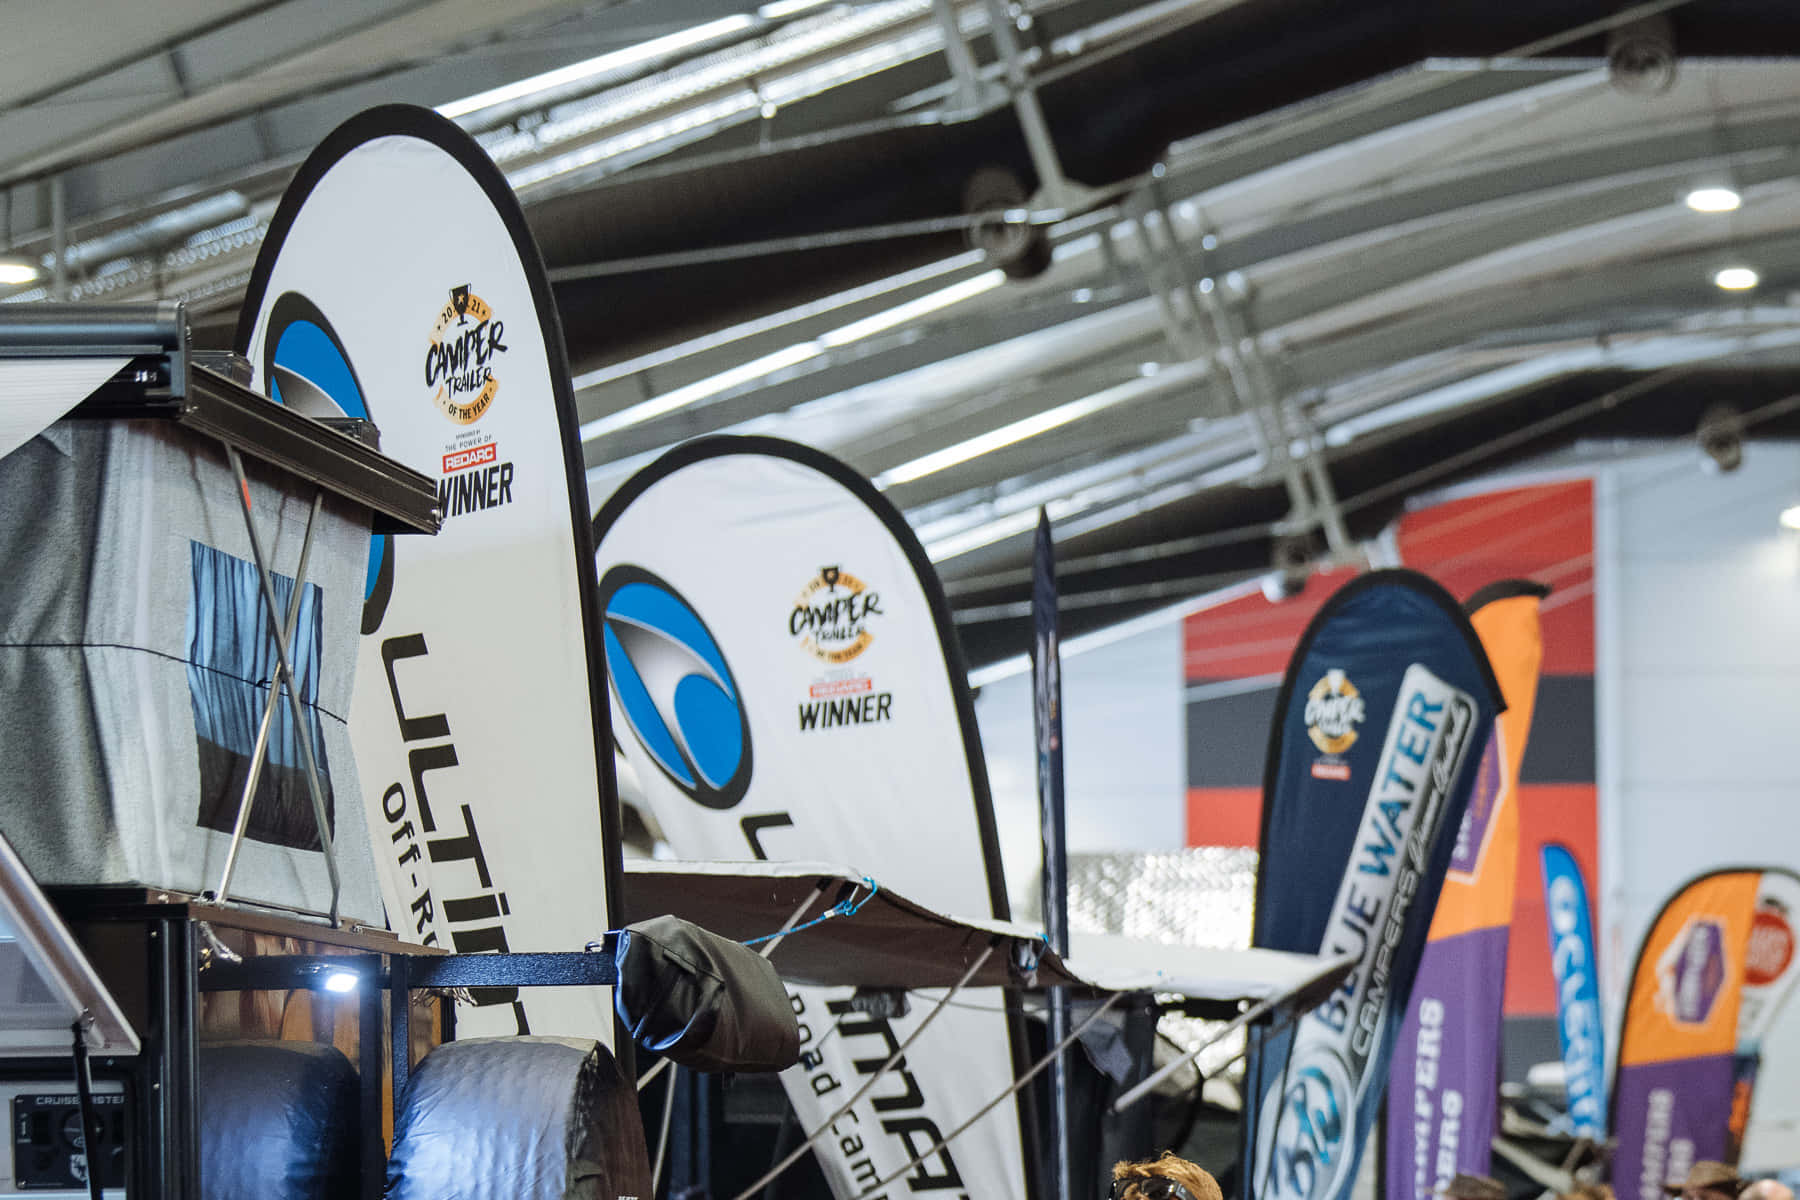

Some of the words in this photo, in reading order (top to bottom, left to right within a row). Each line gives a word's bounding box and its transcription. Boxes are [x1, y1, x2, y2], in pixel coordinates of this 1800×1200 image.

[425, 319, 508, 387] CAMPER
[445, 366, 493, 399] TRAILER
[448, 403, 457, 417] OF
[458, 408, 472, 420] THE
[472, 393, 490, 417] YEAR
[445, 447, 493, 470] REDARC
[435, 462, 514, 519] WINNER
[789, 591, 884, 637] CAMPER
[798, 693, 892, 731] WINNER
[1359, 690, 1446, 894] WATER
[1352, 868, 1422, 1058] CAMPERS
